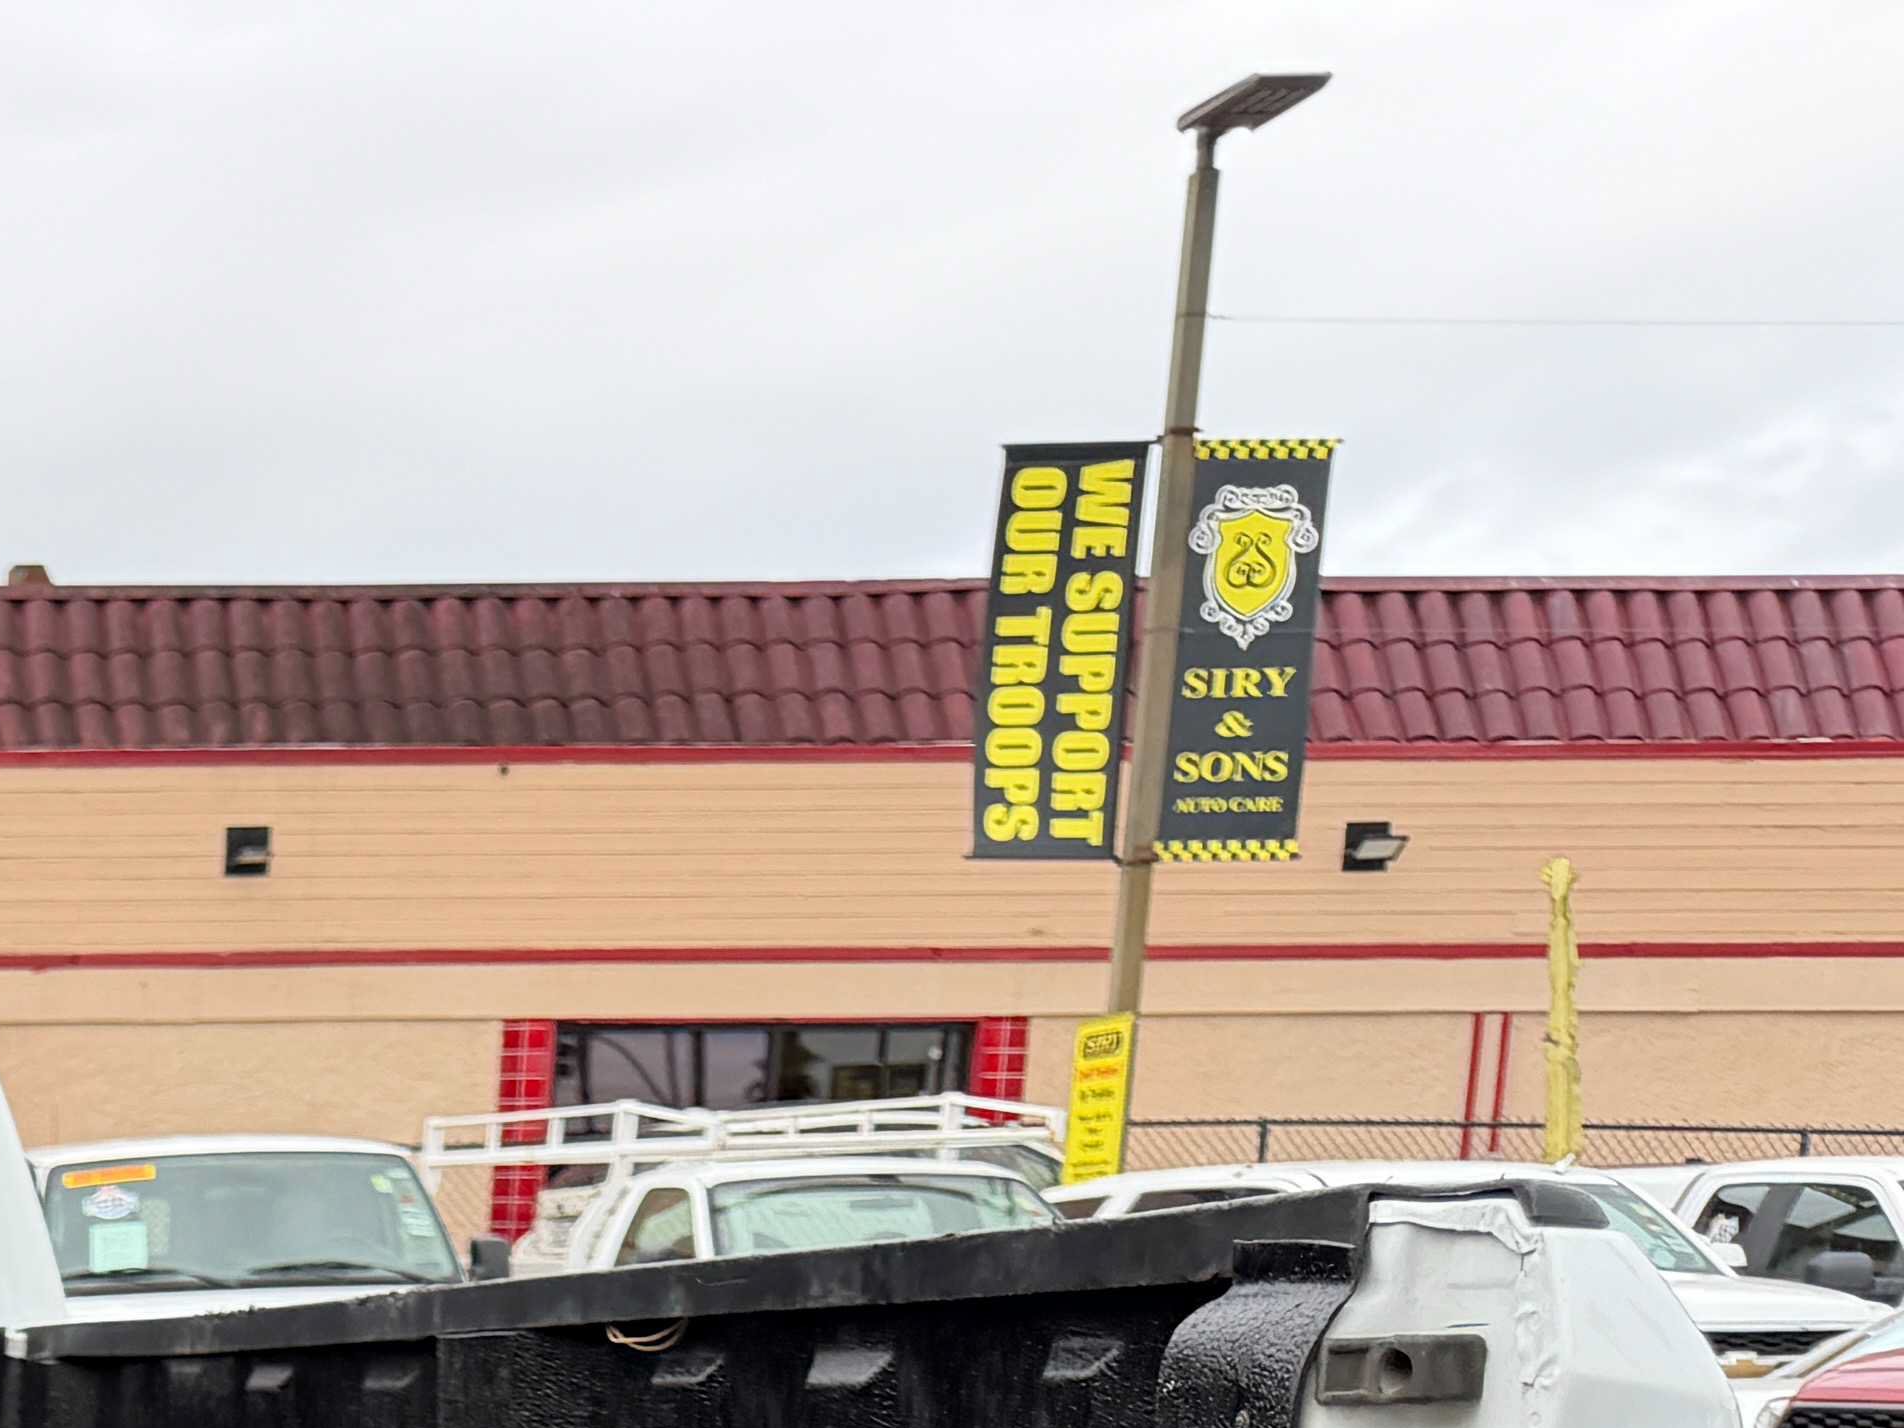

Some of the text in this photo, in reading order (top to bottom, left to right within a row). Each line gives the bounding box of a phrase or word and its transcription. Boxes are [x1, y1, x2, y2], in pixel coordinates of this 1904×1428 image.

[983, 466, 1069, 843] OUR TROOPS
[1049, 459, 1135, 846] WE SUPPORT
[1182, 667, 1296, 700] SIRY
[1215, 711, 1253, 738] &
[1173, 752, 1289, 784] SONS
[1173, 796, 1284, 813] AUTO CARE
